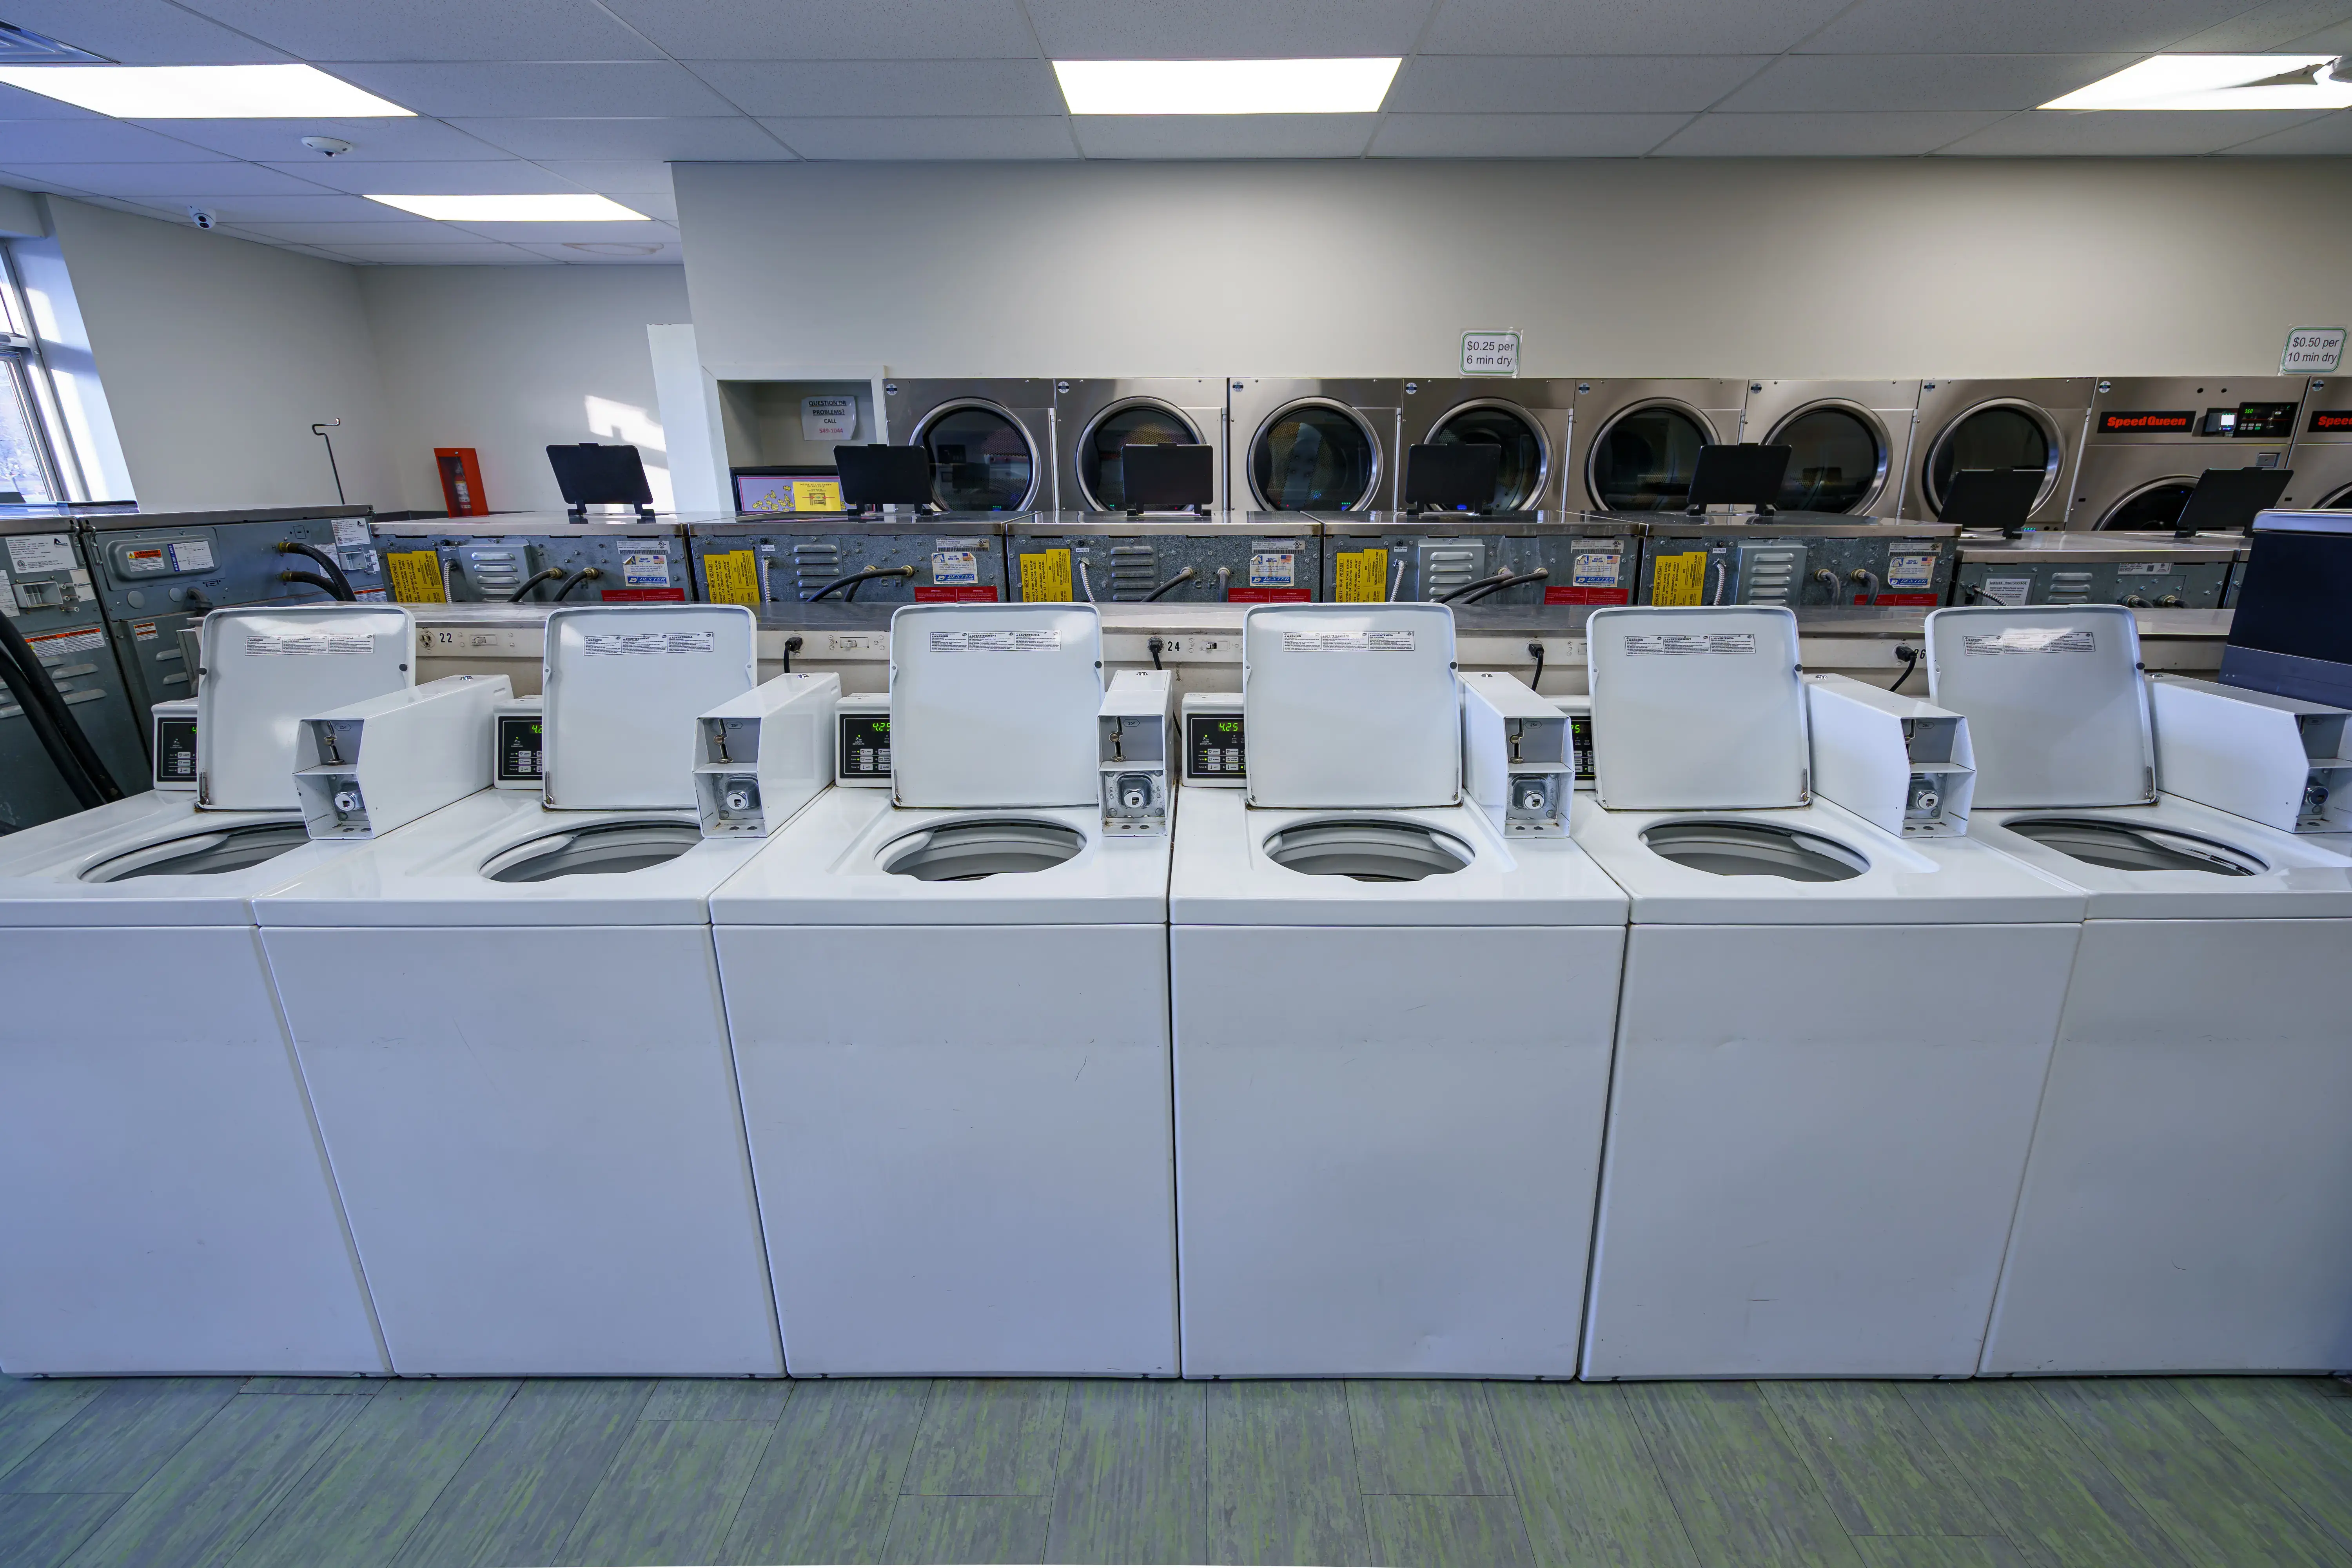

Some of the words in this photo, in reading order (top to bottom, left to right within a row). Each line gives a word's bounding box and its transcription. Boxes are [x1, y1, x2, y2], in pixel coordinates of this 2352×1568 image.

[1467, 341, 1495, 351] $0.25
[1498, 344, 1514, 352] per
[2293, 337, 2320, 348] $0.50
[2322, 340, 2339, 349] per
[1467, 355, 1472, 364] 6
[1476, 356, 1493, 364] min
[1497, 356, 1512, 367] dry
[2288, 352, 2299, 361] 10
[2302, 353, 2319, 361] min
[2322, 352, 2337, 364] dry
[2107, 416, 2147, 428] Speed
[2147, 416, 2186, 425] Queen
[439, 633, 452, 642] 22
[1168, 641, 1180, 651] 24
[1219, 723, 1238, 731] 4.25
